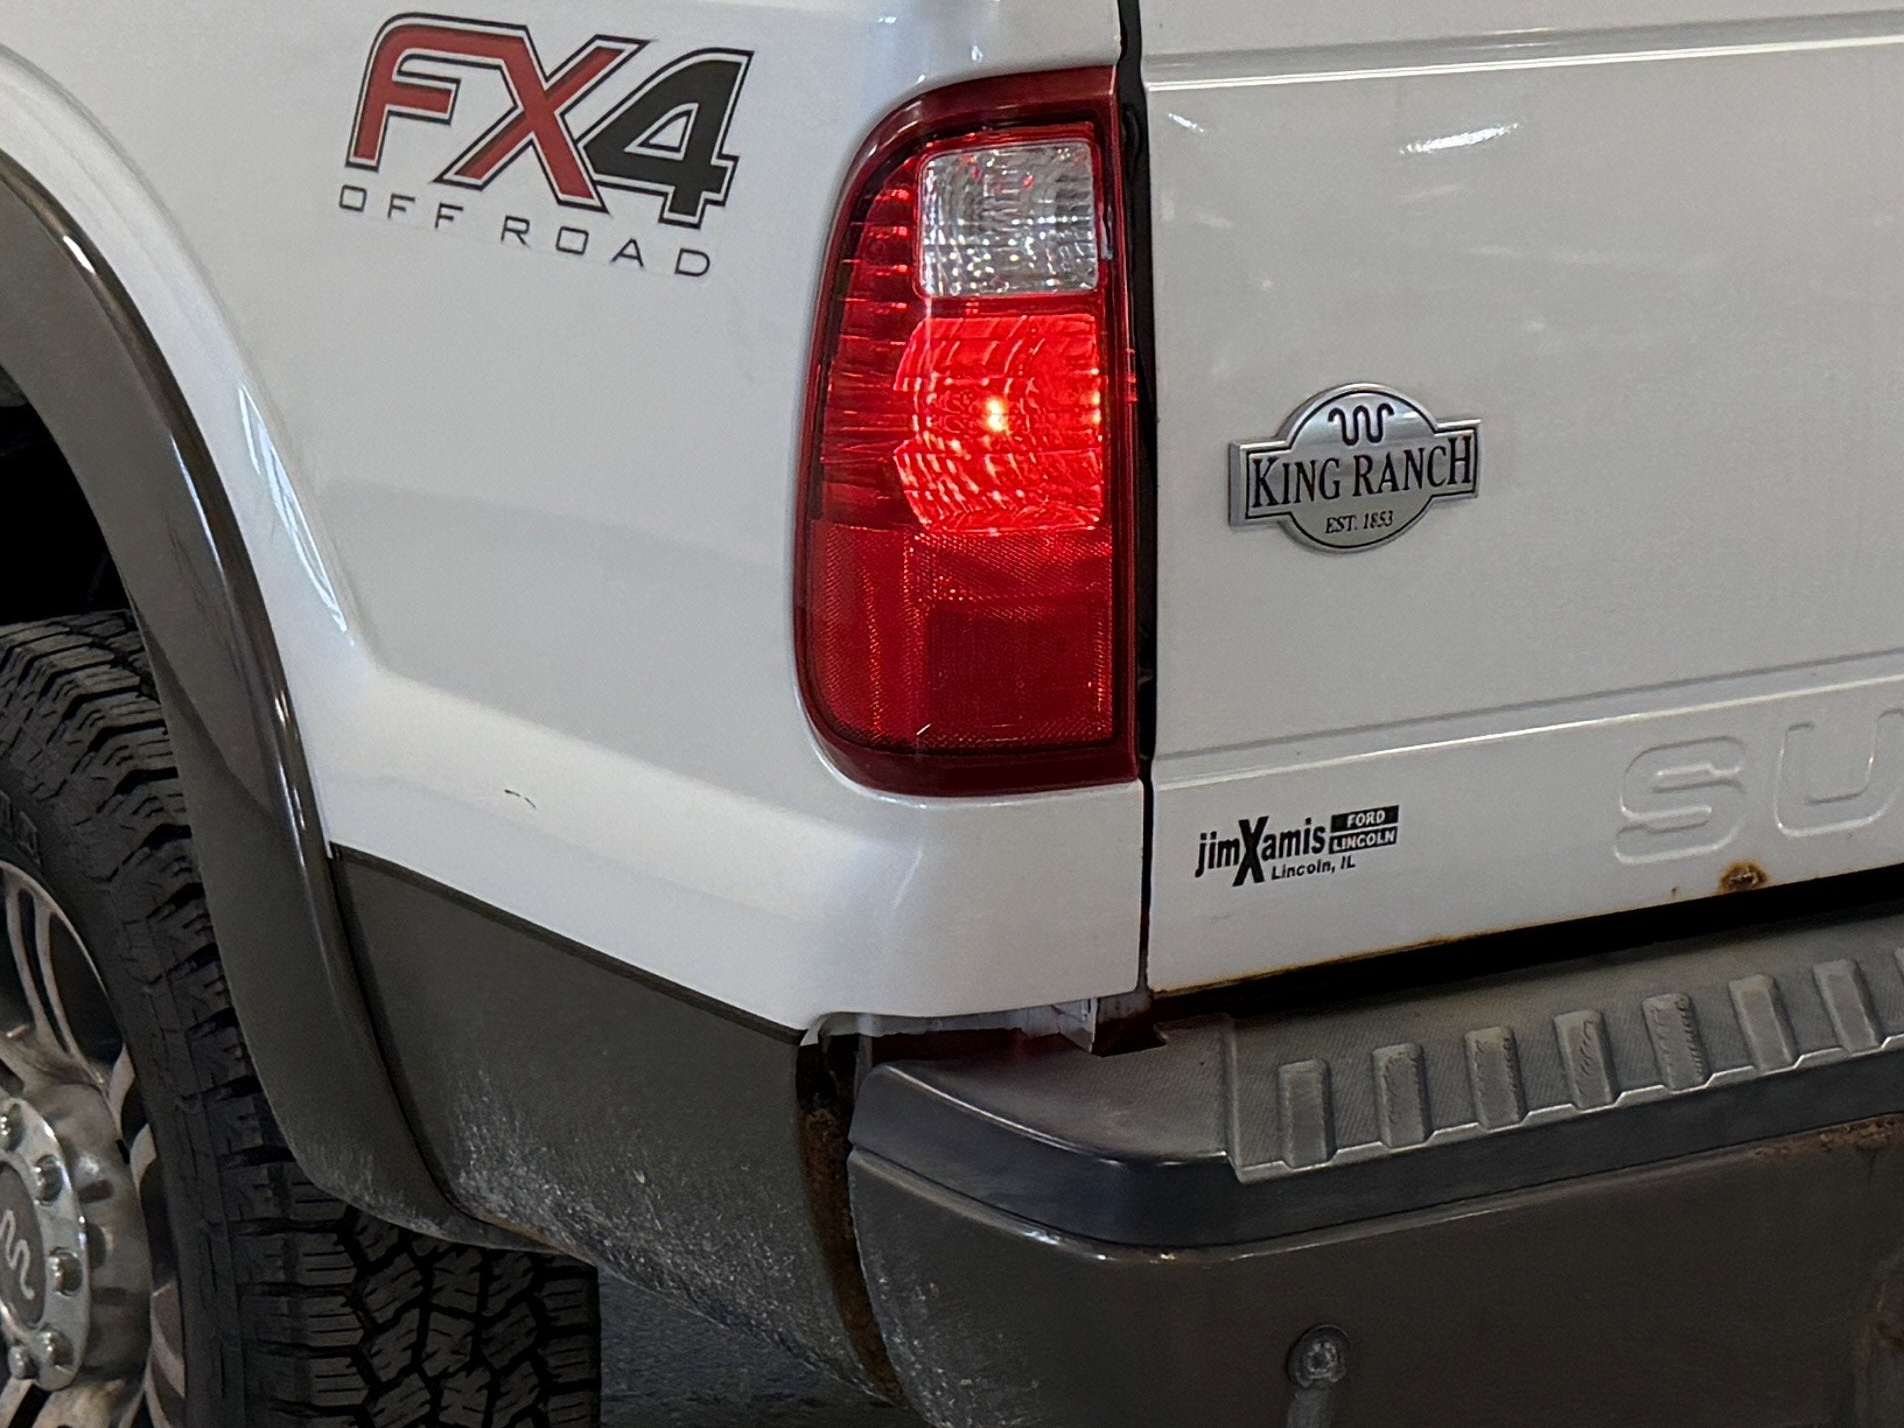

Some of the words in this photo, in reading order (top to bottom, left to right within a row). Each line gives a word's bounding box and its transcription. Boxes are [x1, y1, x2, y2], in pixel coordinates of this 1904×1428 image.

[344, 12, 756, 231] FX4
[1251, 456, 1340, 509] KING
[1352, 436, 1473, 495] RANCH
[1325, 513, 1359, 534] EST.
[1363, 510, 1394, 531] 1853
[1346, 809, 1387, 828] FORD
[1332, 827, 1396, 851] LINCOLN
[1271, 858, 1337, 881] Lincoln,
[1341, 854, 1357, 872] IL
